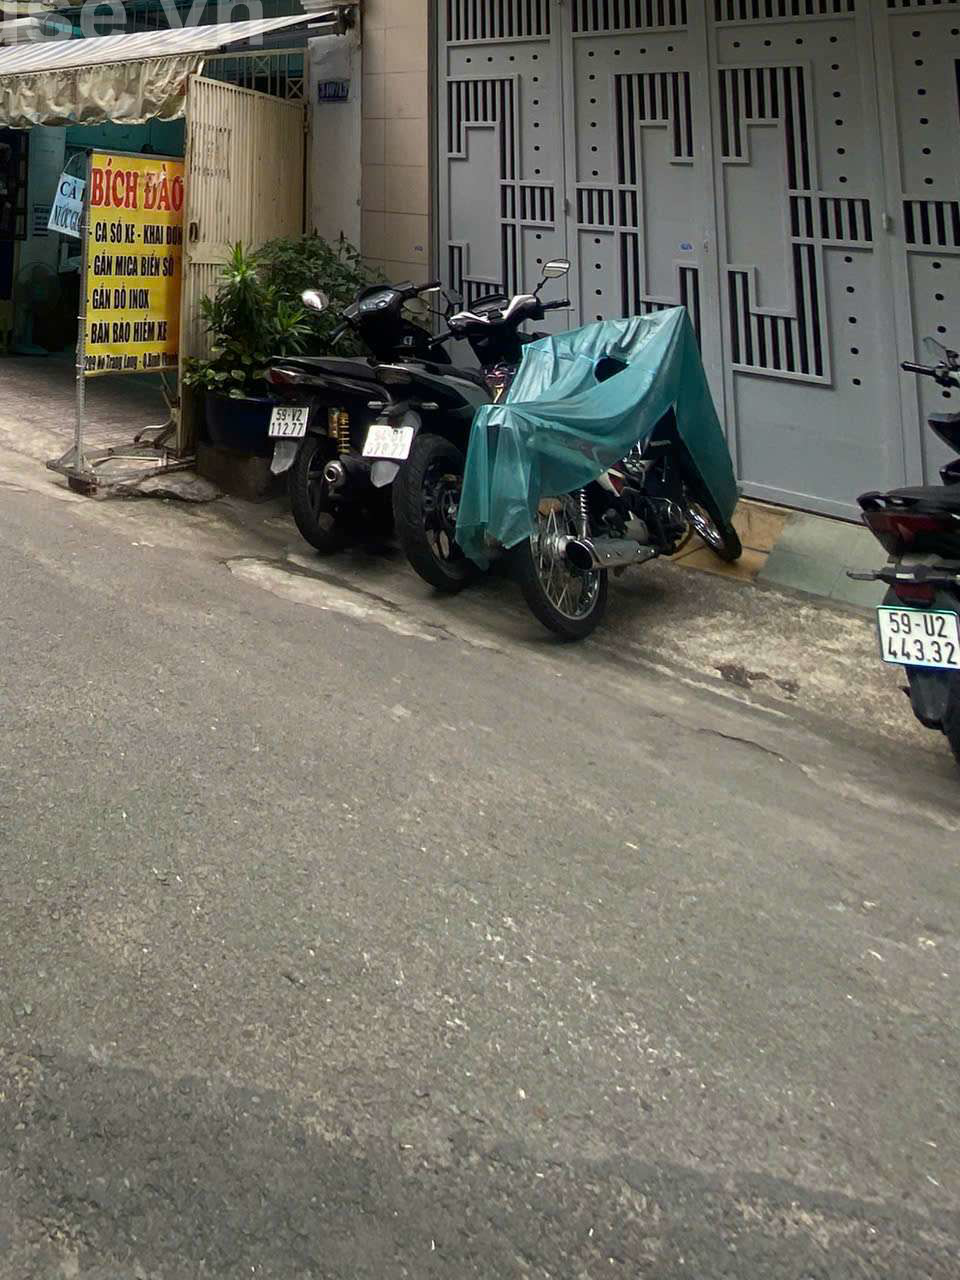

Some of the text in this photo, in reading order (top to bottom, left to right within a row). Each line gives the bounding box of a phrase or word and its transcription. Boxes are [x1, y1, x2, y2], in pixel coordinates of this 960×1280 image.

[90, 157, 139, 208] BÍCH
[125, 223, 135, 244] XE
[143, 224, 164, 245] KHAI
[115, 255, 138, 276] MICA
[128, 288, 150, 309] INOX
[157, 321, 167, 341] XE
[889, 612, 948, 638] 59-U2
[888, 636, 958, 665] 443.32
